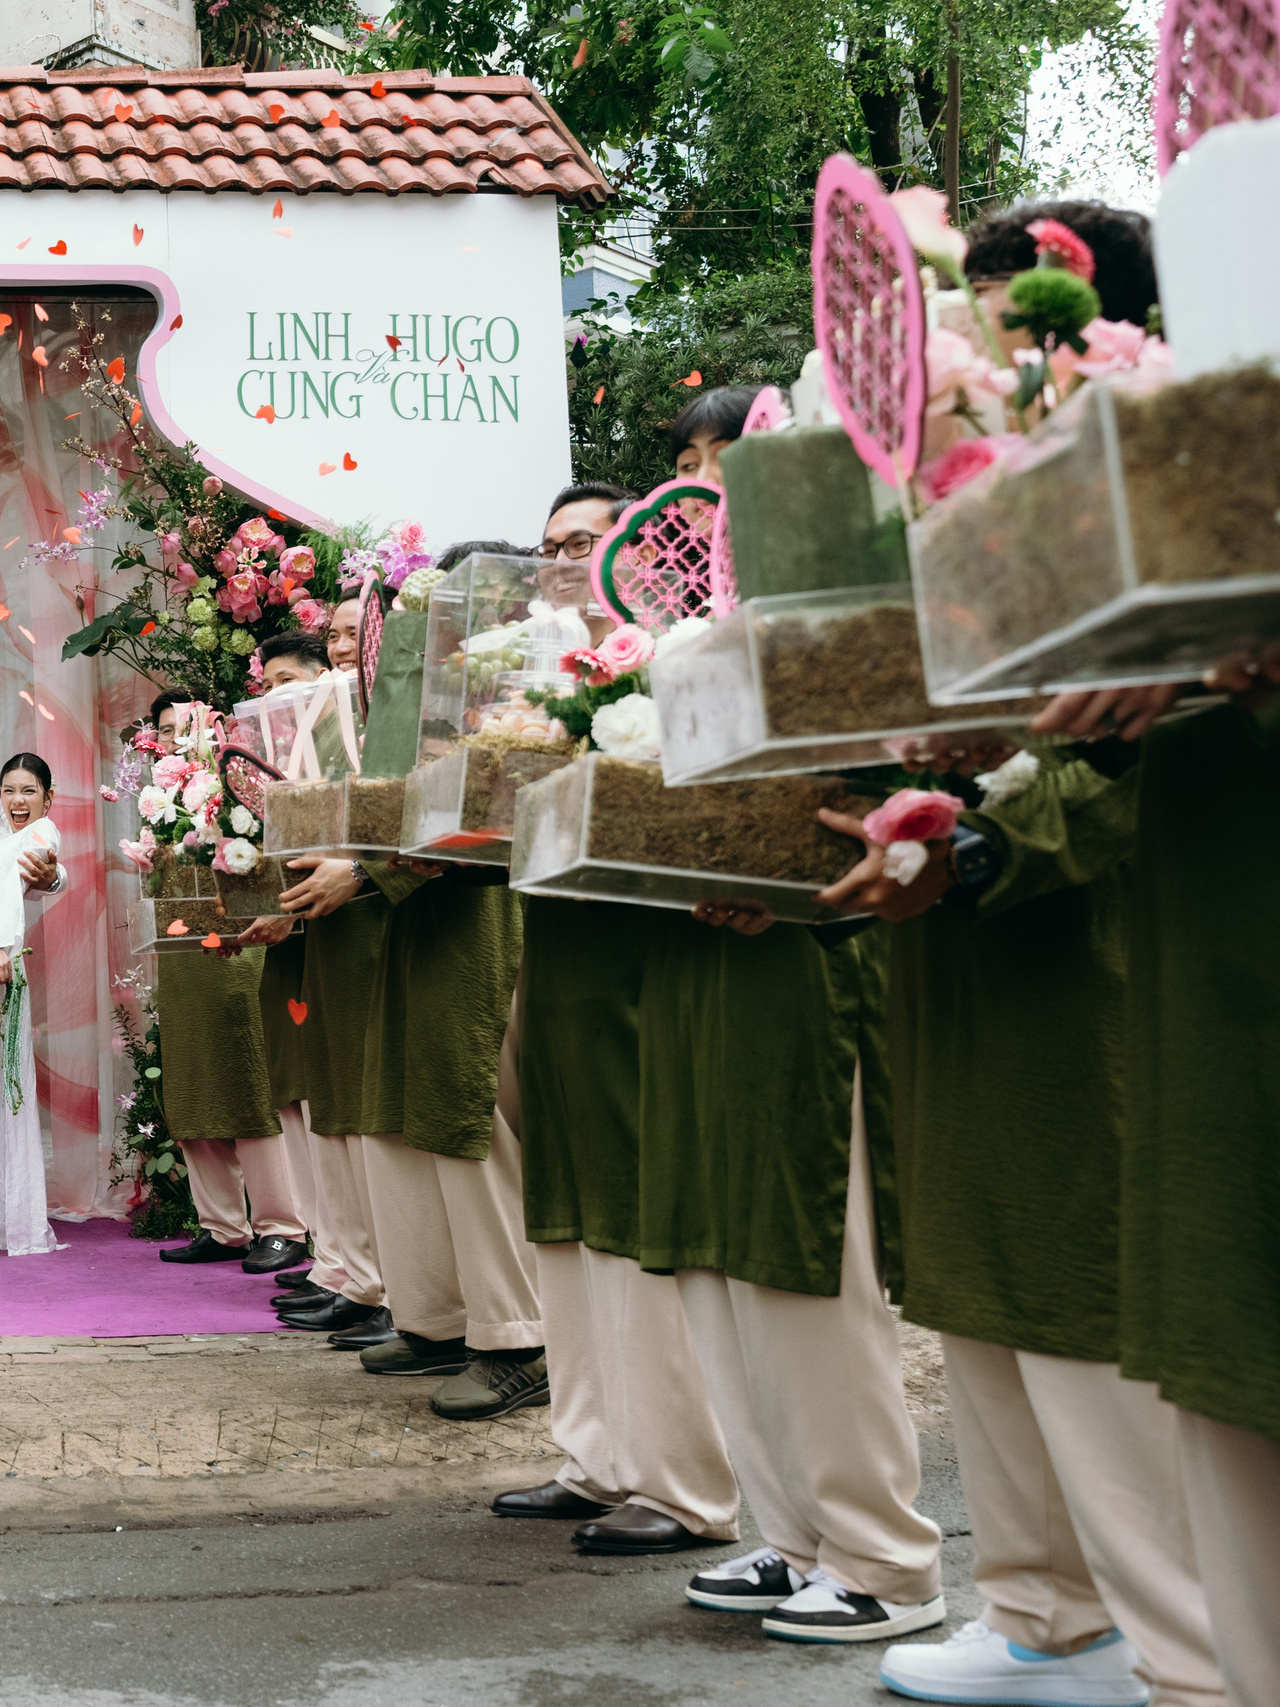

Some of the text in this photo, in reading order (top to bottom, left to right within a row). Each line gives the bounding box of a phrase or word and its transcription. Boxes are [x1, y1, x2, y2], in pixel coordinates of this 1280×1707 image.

[246, 311, 520, 364] LINH HUGO
[237, 369, 520, 424] CUNG CHAN
